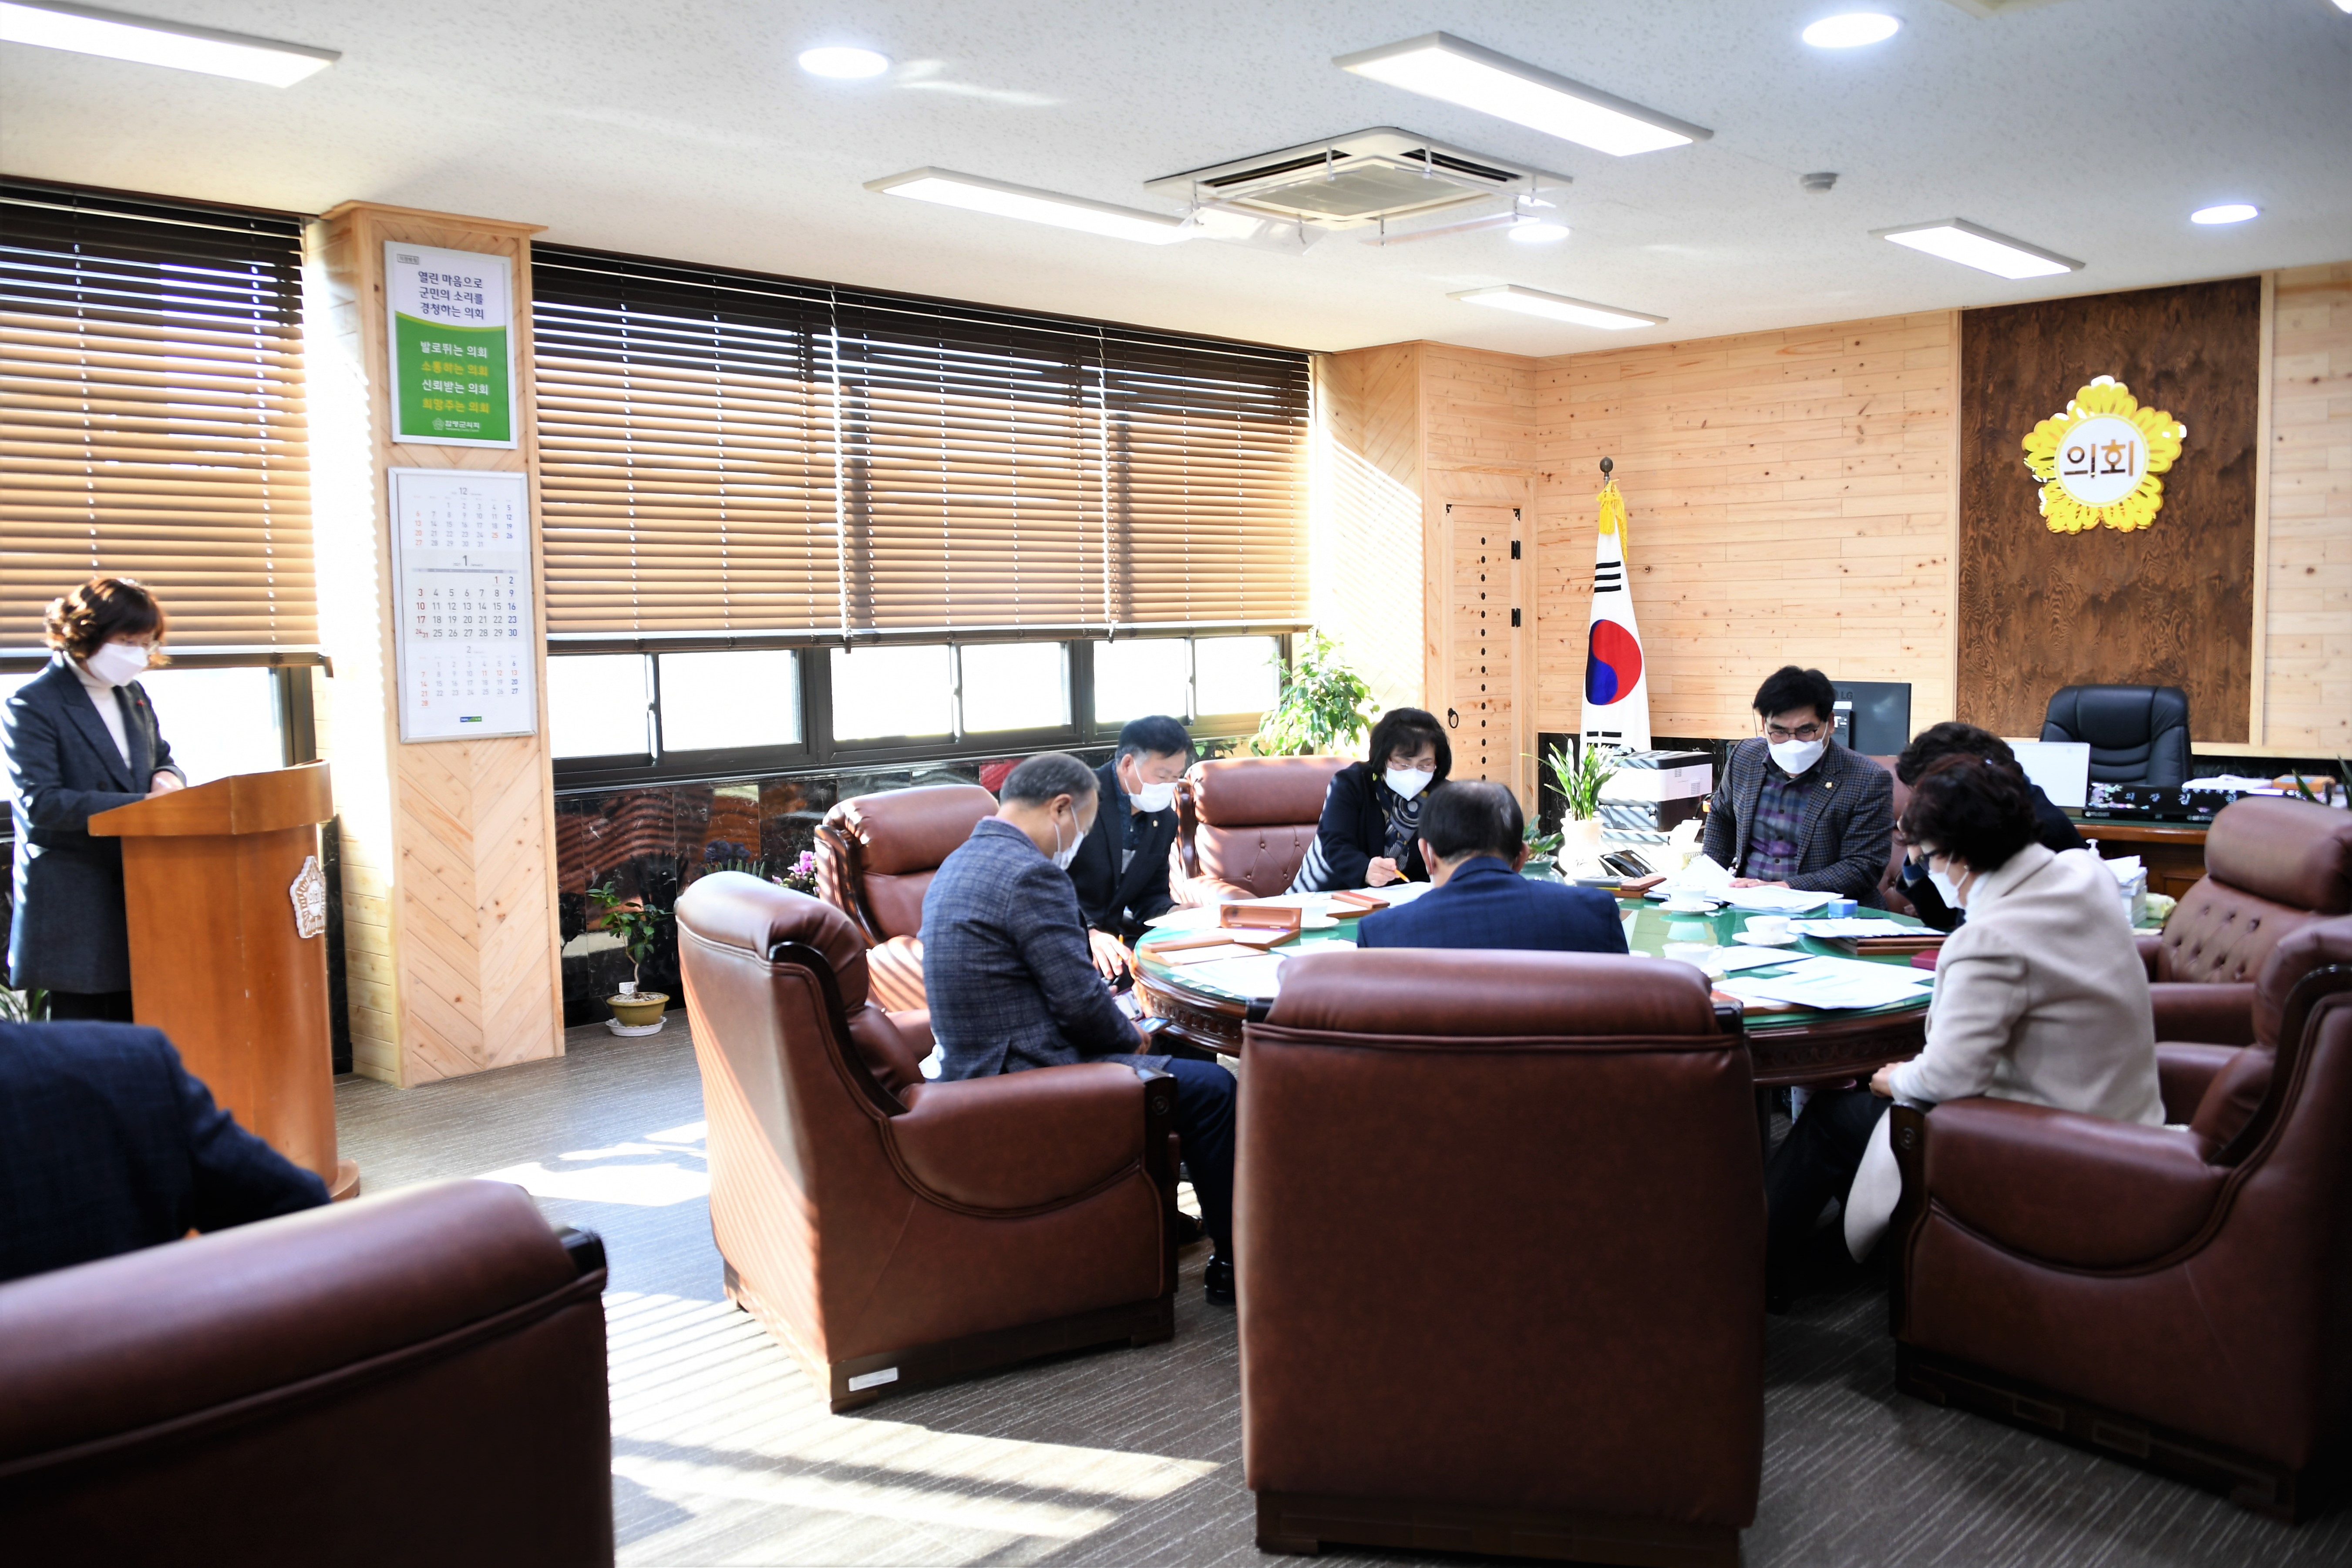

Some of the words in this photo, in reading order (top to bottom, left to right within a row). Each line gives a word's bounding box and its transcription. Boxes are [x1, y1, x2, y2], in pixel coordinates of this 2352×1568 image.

[418, 271, 439, 285] 열린
[442, 274, 483, 289] 마음으로
[419, 287, 450, 301] 군민의
[454, 291, 483, 305] 소리를
[420, 302, 461, 318] 경청하는
[464, 307, 484, 320] 의회
[421, 341, 464, 356] 발로뛰는
[467, 346, 488, 358] 의회
[421, 361, 464, 375] 소통하는
[468, 364, 488, 376] 의회
[422, 379, 464, 394] 신뢰받는
[468, 383, 488, 395] 의회
[422, 398, 465, 413] 희망주는
[469, 402, 489, 413] 의회
[2064, 440, 2134, 479] 의회
[459, 487, 468, 495] 12
[463, 555, 468, 566] 1
[509, 576, 513, 584] 2
[418, 588, 423, 597] 3
[417, 602, 425, 610] 10
[417, 615, 426, 624] 17
[433, 615, 441, 624] 18
[448, 615, 457, 624] 19
[479, 615, 487, 624] 21
[493, 615, 502, 624] 22
[508, 615, 517, 624] 23
[433, 629, 442, 637] 25
[448, 629, 458, 637] 26
[464, 629, 473, 637] 27
[479, 629, 488, 637] 28
[1841, 691, 1853, 699] LG
